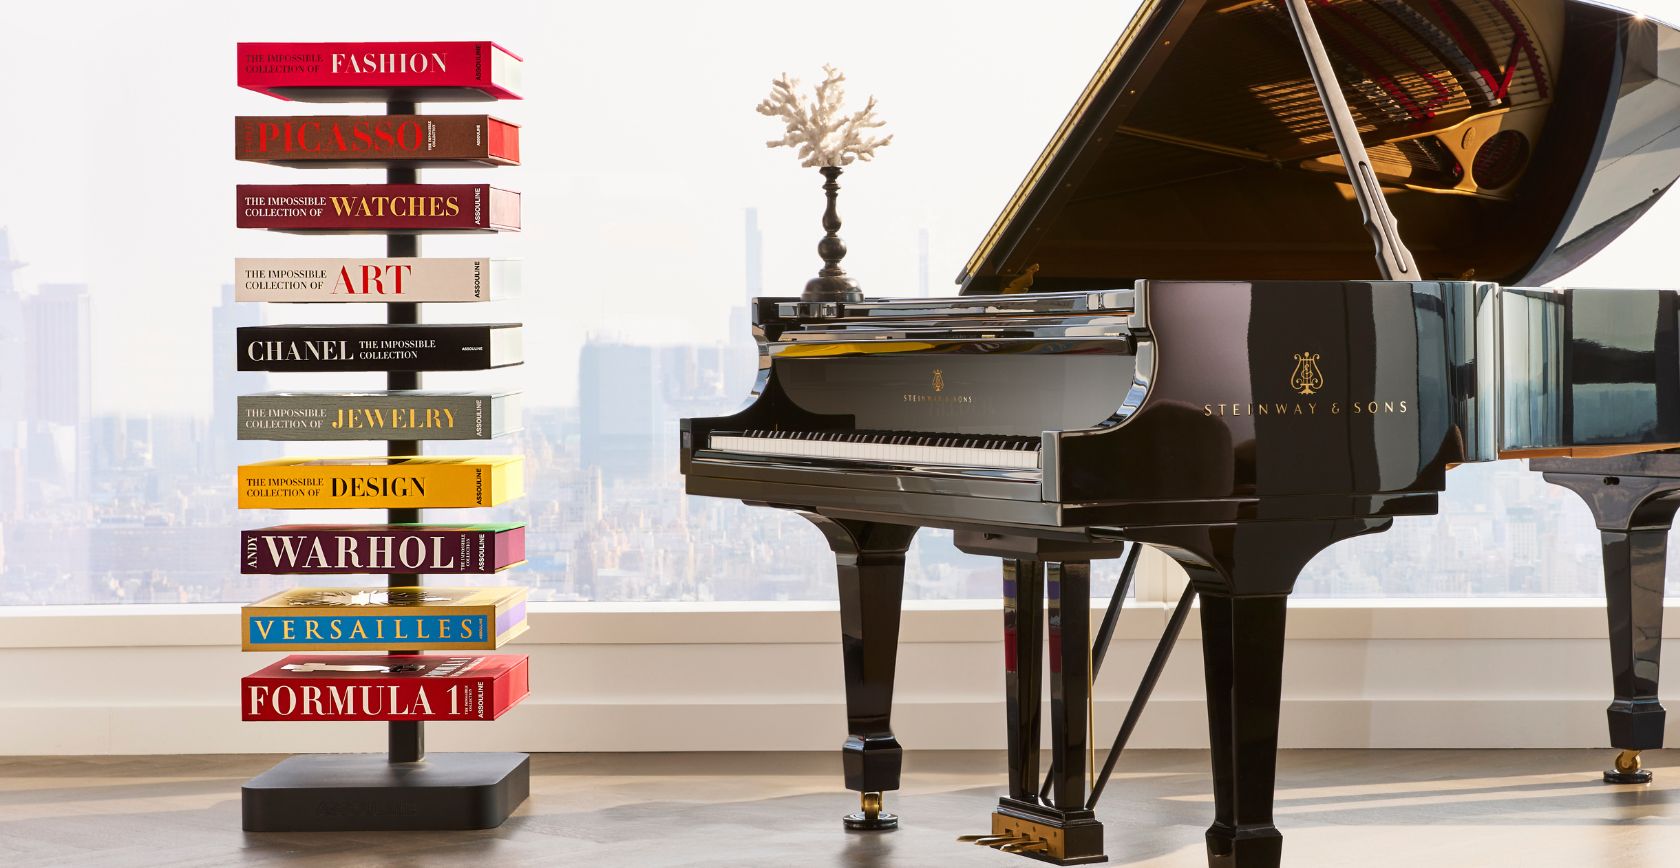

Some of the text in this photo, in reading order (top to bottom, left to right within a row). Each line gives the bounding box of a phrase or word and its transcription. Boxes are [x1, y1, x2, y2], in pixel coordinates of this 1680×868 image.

[330, 53, 447, 74] FASHION
[258, 121, 423, 153] PICASSO
[245, 197, 327, 206] THE IMPOSSIBLE
[329, 196, 460, 217] WATCHES
[245, 208, 323, 217] COLLECTION OF
[245, 270, 327, 279] THE IMPOSSIBLE
[330, 265, 412, 295] ART
[245, 281, 324, 290] COLLECTION OF
[247, 340, 354, 362] CHANEL
[359, 340, 436, 349] THE IMPOSSIBLE
[359, 350, 418, 360] COLLECTION
[245, 408, 327, 418] THE IMPOSSIBLE
[1204, 400, 1407, 416] STEINWAY & SONS
[245, 420, 323, 429] COLLECTION OF
[331, 407, 458, 430] JEWELRY
[246, 478, 324, 487] THE IMPOSSIBLE
[331, 477, 426, 497] DESIGN
[246, 488, 321, 497] COLLECTION OF
[246, 535, 258, 568] ANDY
[261, 535, 454, 569] WARHOL
[255, 618, 472, 640] VERSAILLES
[248, 684, 461, 716] FORMULA 1
